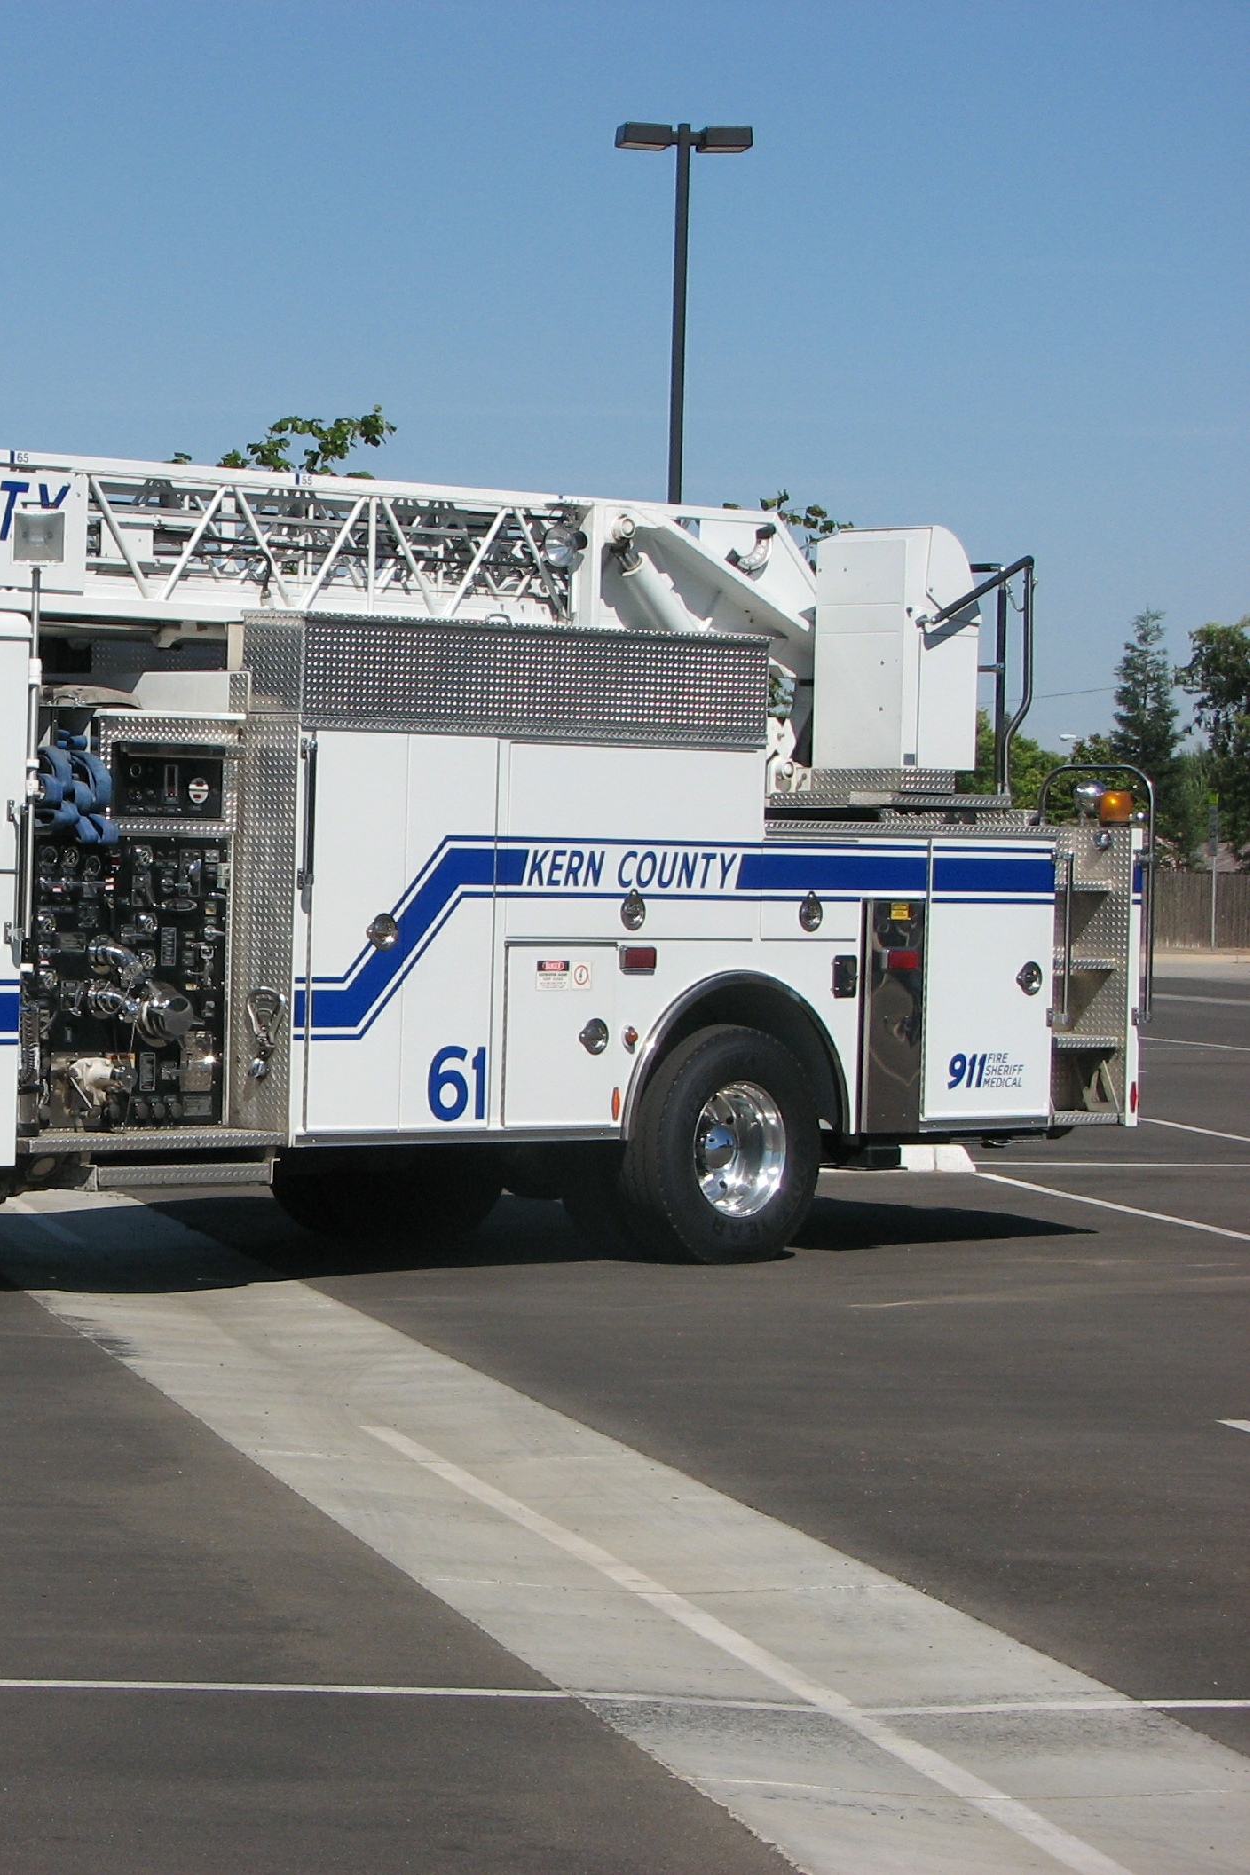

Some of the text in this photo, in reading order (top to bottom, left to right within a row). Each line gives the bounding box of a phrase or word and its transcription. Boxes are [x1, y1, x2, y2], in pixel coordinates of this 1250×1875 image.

[16, 452, 29, 463] 65
[527, 849, 738, 890] KERN COUNTY
[987, 1053, 1009, 1064] FIRE
[947, 1053, 987, 1090] 911
[985, 1064, 1024, 1076] SHERIFF
[428, 1045, 486, 1122] 61
[982, 1077, 1022, 1088] MEDICAL
